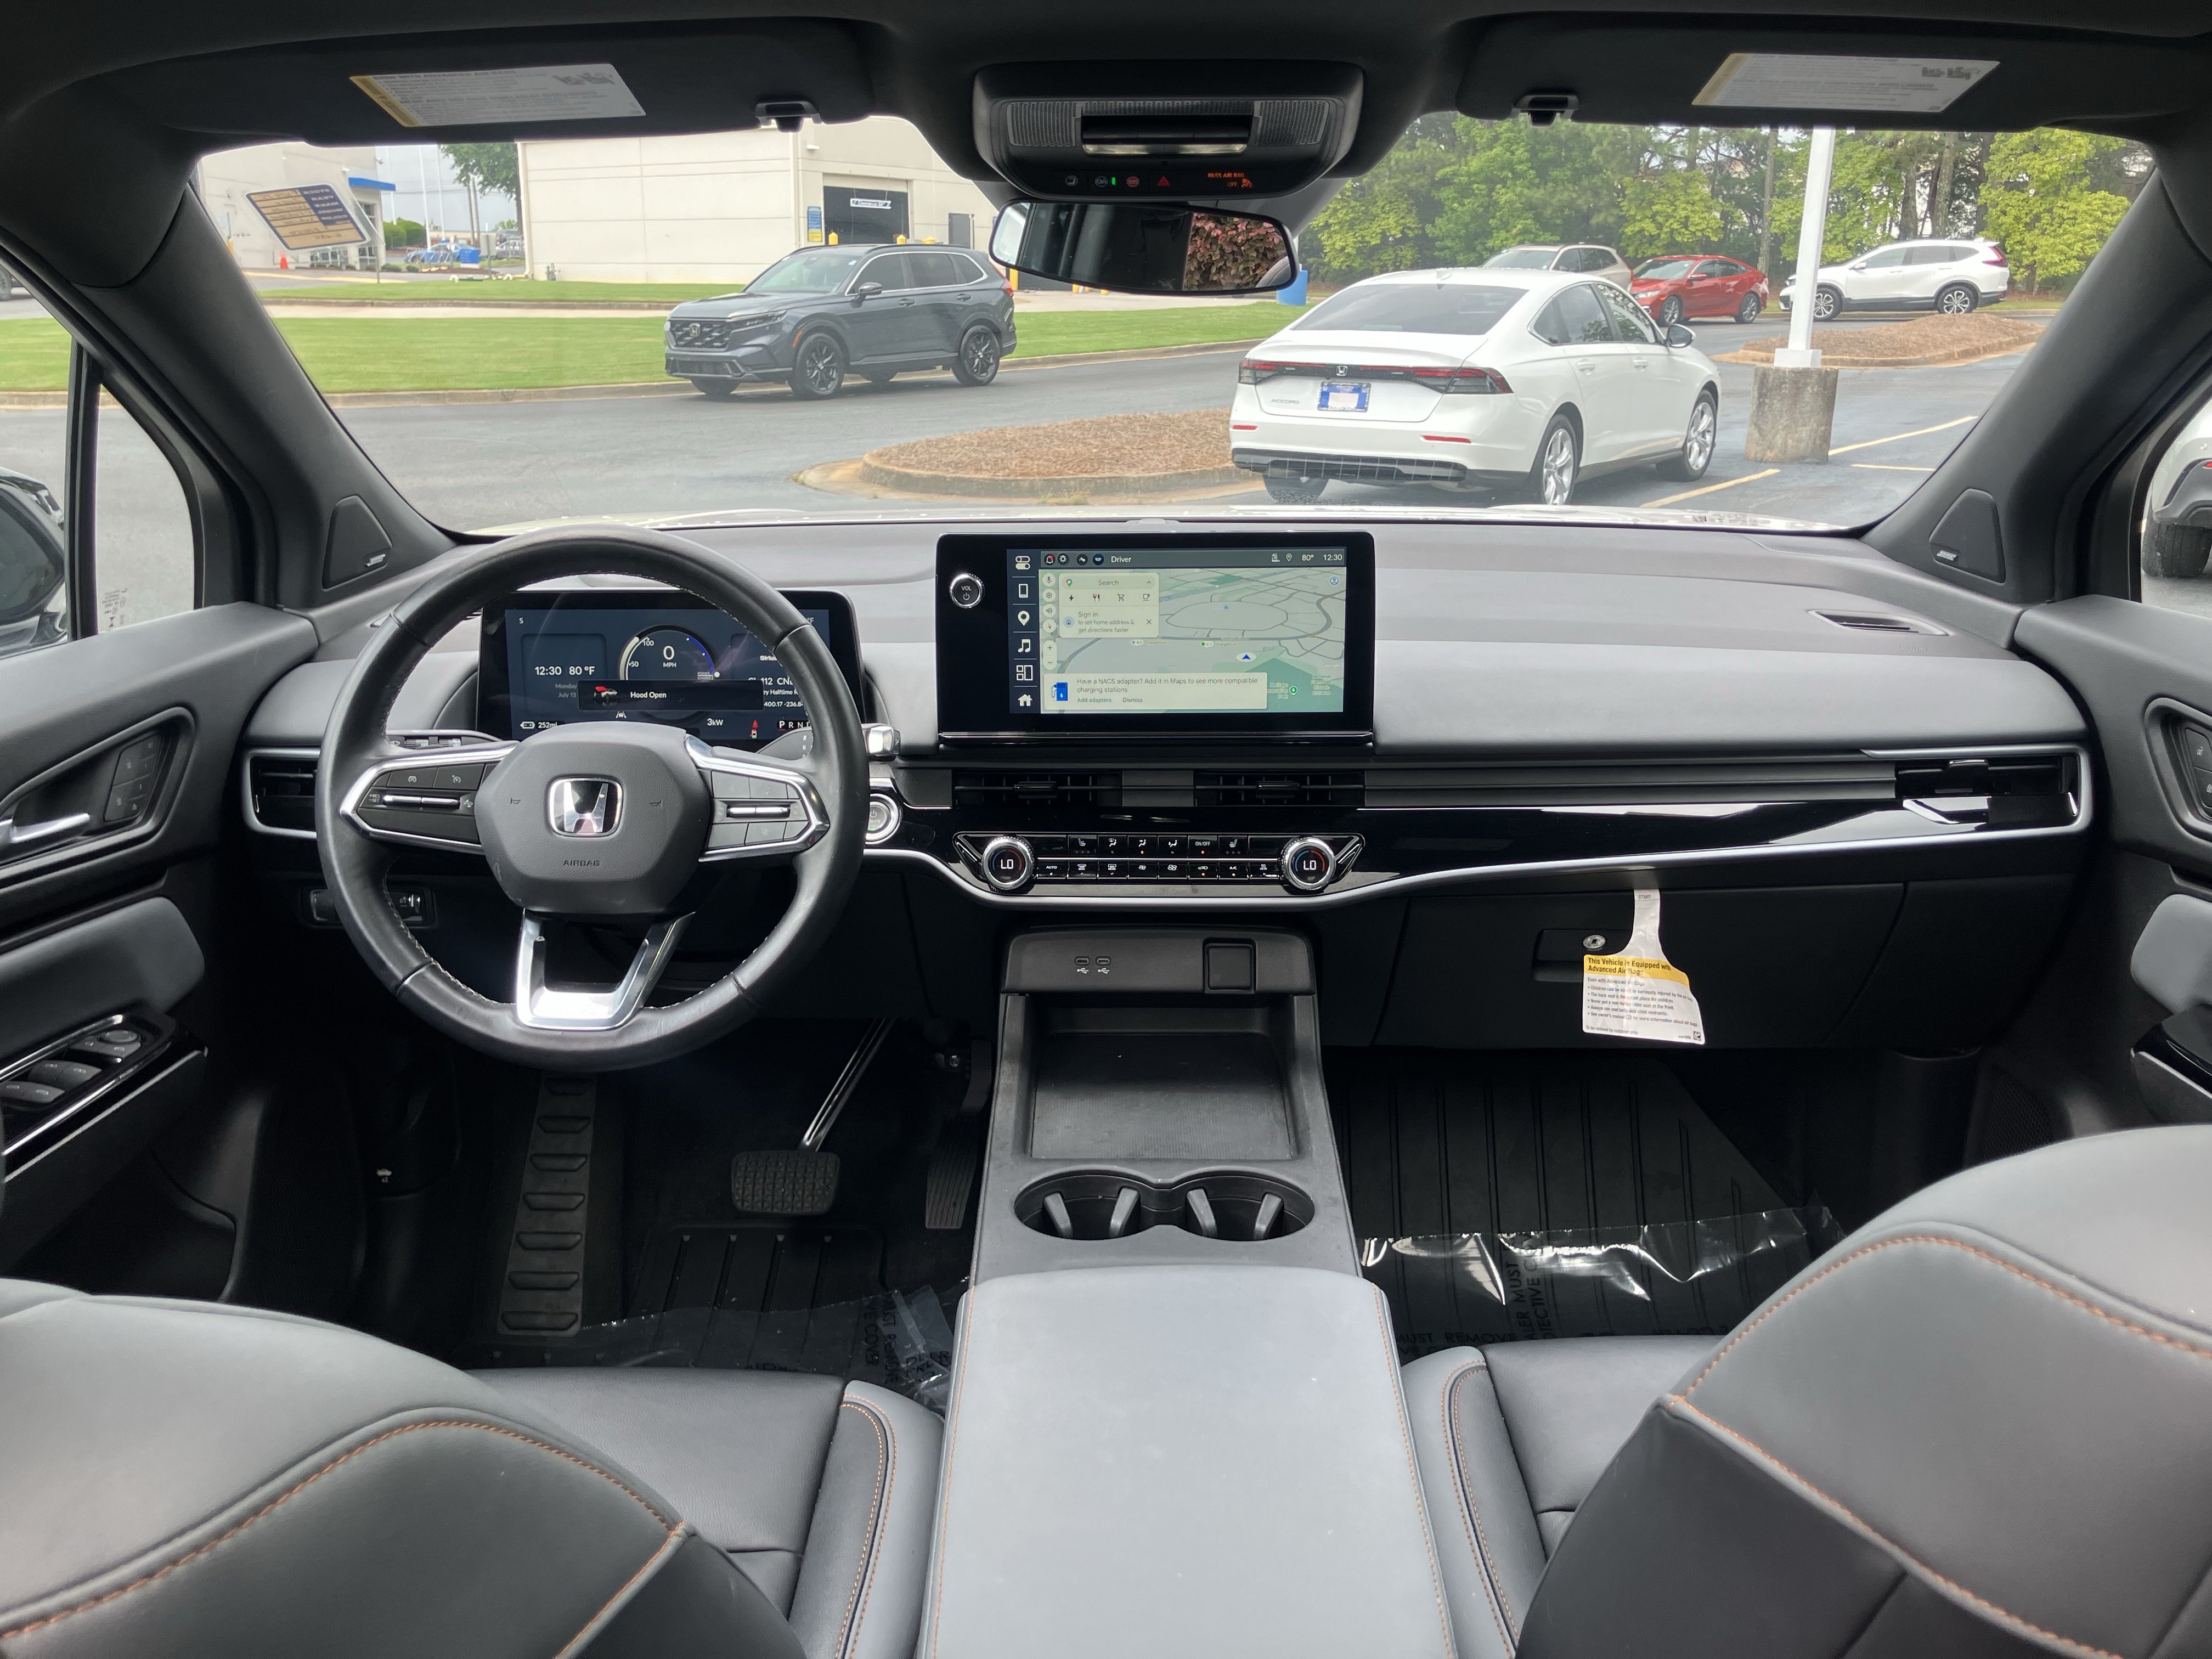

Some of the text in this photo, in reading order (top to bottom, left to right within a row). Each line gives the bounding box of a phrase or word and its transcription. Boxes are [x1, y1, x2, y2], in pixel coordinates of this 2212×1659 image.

[663, 645, 675, 660] 0
[534, 666, 562, 675] 12:30
[569, 666, 582, 675] 80
[707, 718, 723, 726] 3kW
[779, 720, 785, 729] P
[1601, 958, 1623, 966] Vehicle
[1632, 961, 1660, 969] Equipped
[1588, 965, 1616, 973] Advanced
